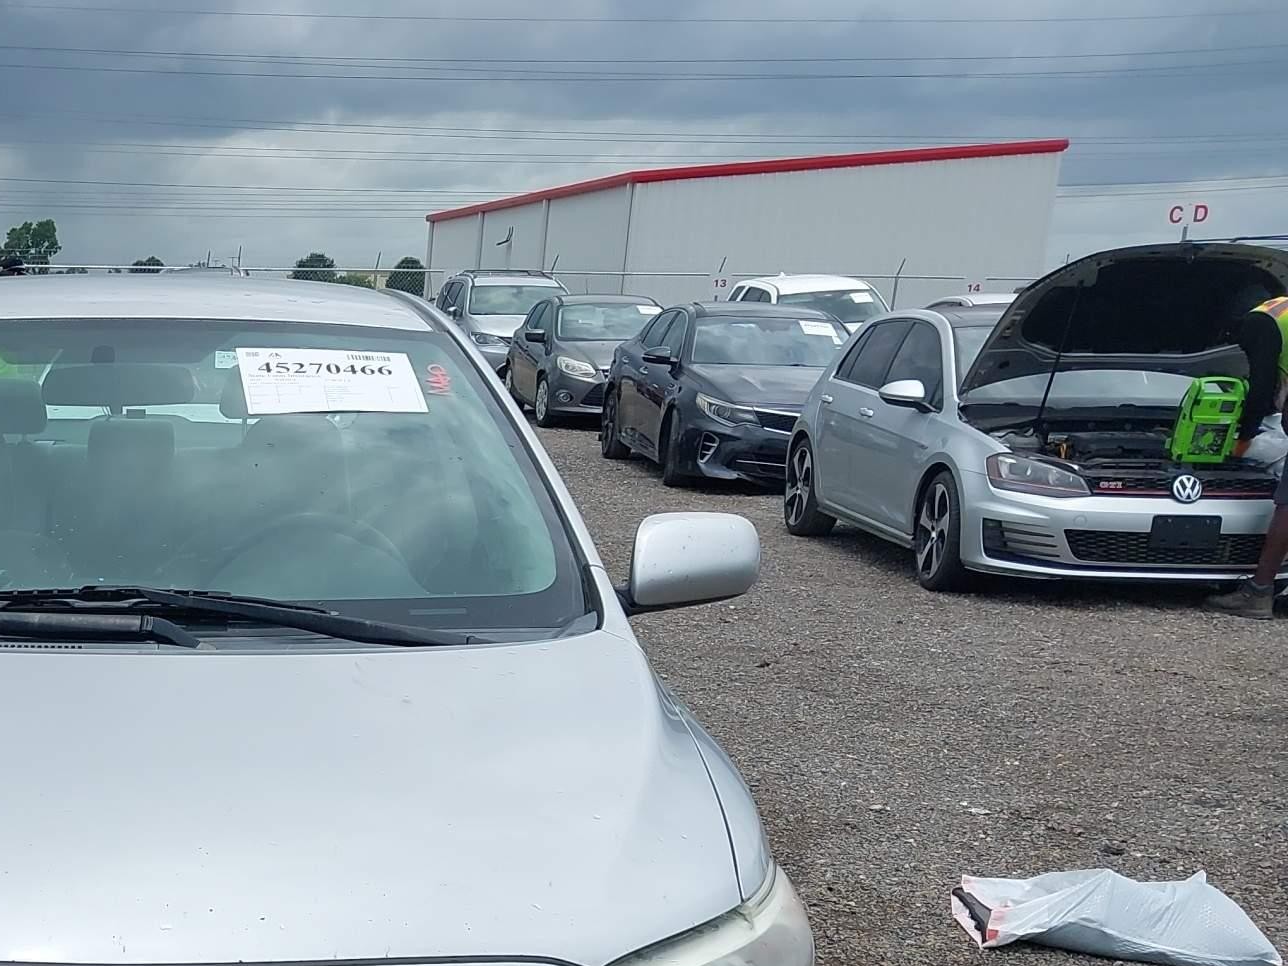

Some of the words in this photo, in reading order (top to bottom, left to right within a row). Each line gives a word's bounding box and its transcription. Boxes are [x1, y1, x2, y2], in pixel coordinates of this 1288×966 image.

[1169, 205, 1183, 224] C
[1193, 204, 1209, 223] D
[713, 279, 727, 288] 13
[967, 284, 981, 293] 14
[257, 361, 393, 377] 45270466
[1099, 481, 1123, 489] GTI
